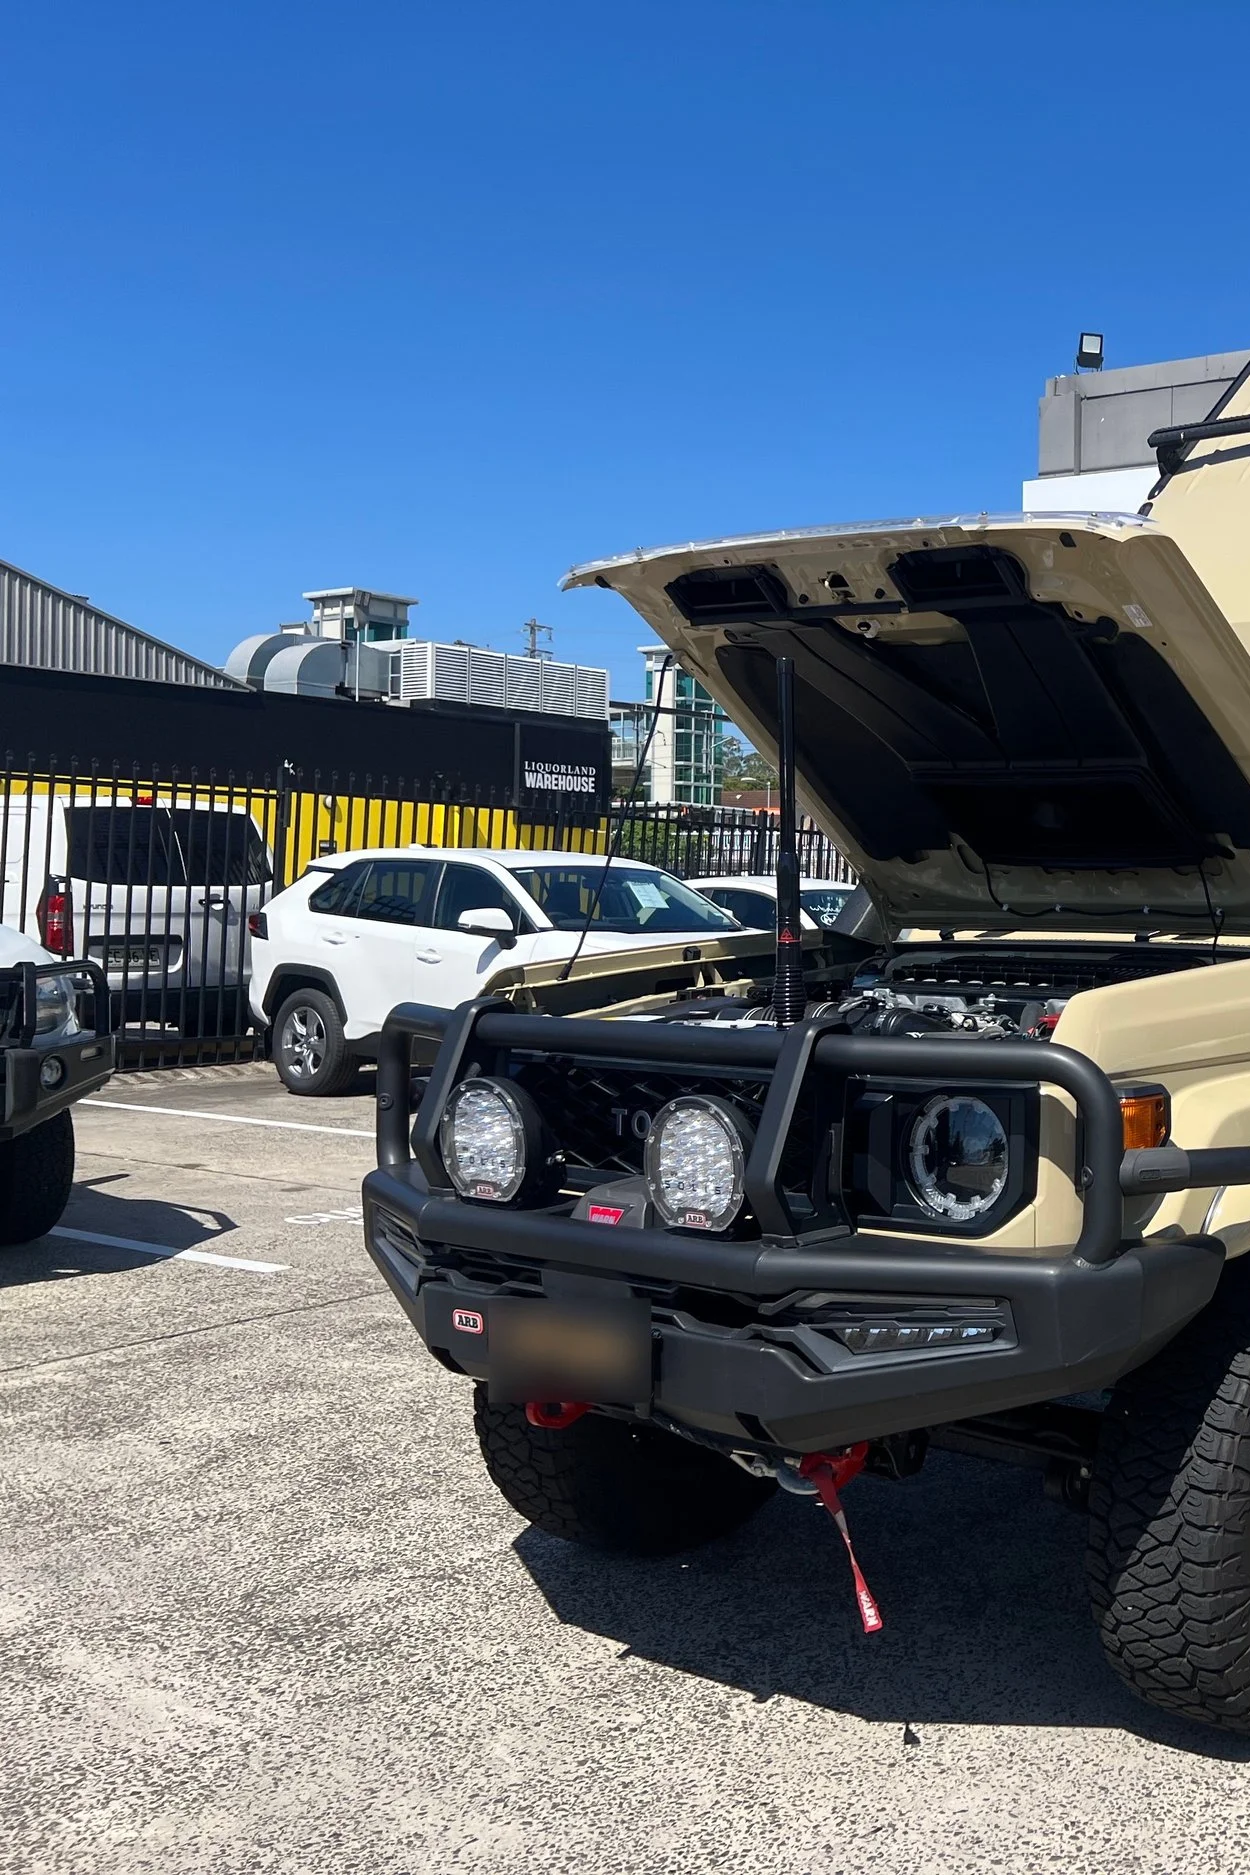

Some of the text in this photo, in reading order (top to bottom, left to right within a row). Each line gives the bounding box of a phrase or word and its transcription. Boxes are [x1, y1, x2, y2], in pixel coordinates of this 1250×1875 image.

[524, 760, 596, 776] LIQUORLAND
[524, 771, 596, 793] WAREHOUSE
[687, 1213, 704, 1224] ARB
[457, 1314, 479, 1329] ARB
[859, 1590, 879, 1627] WARN
